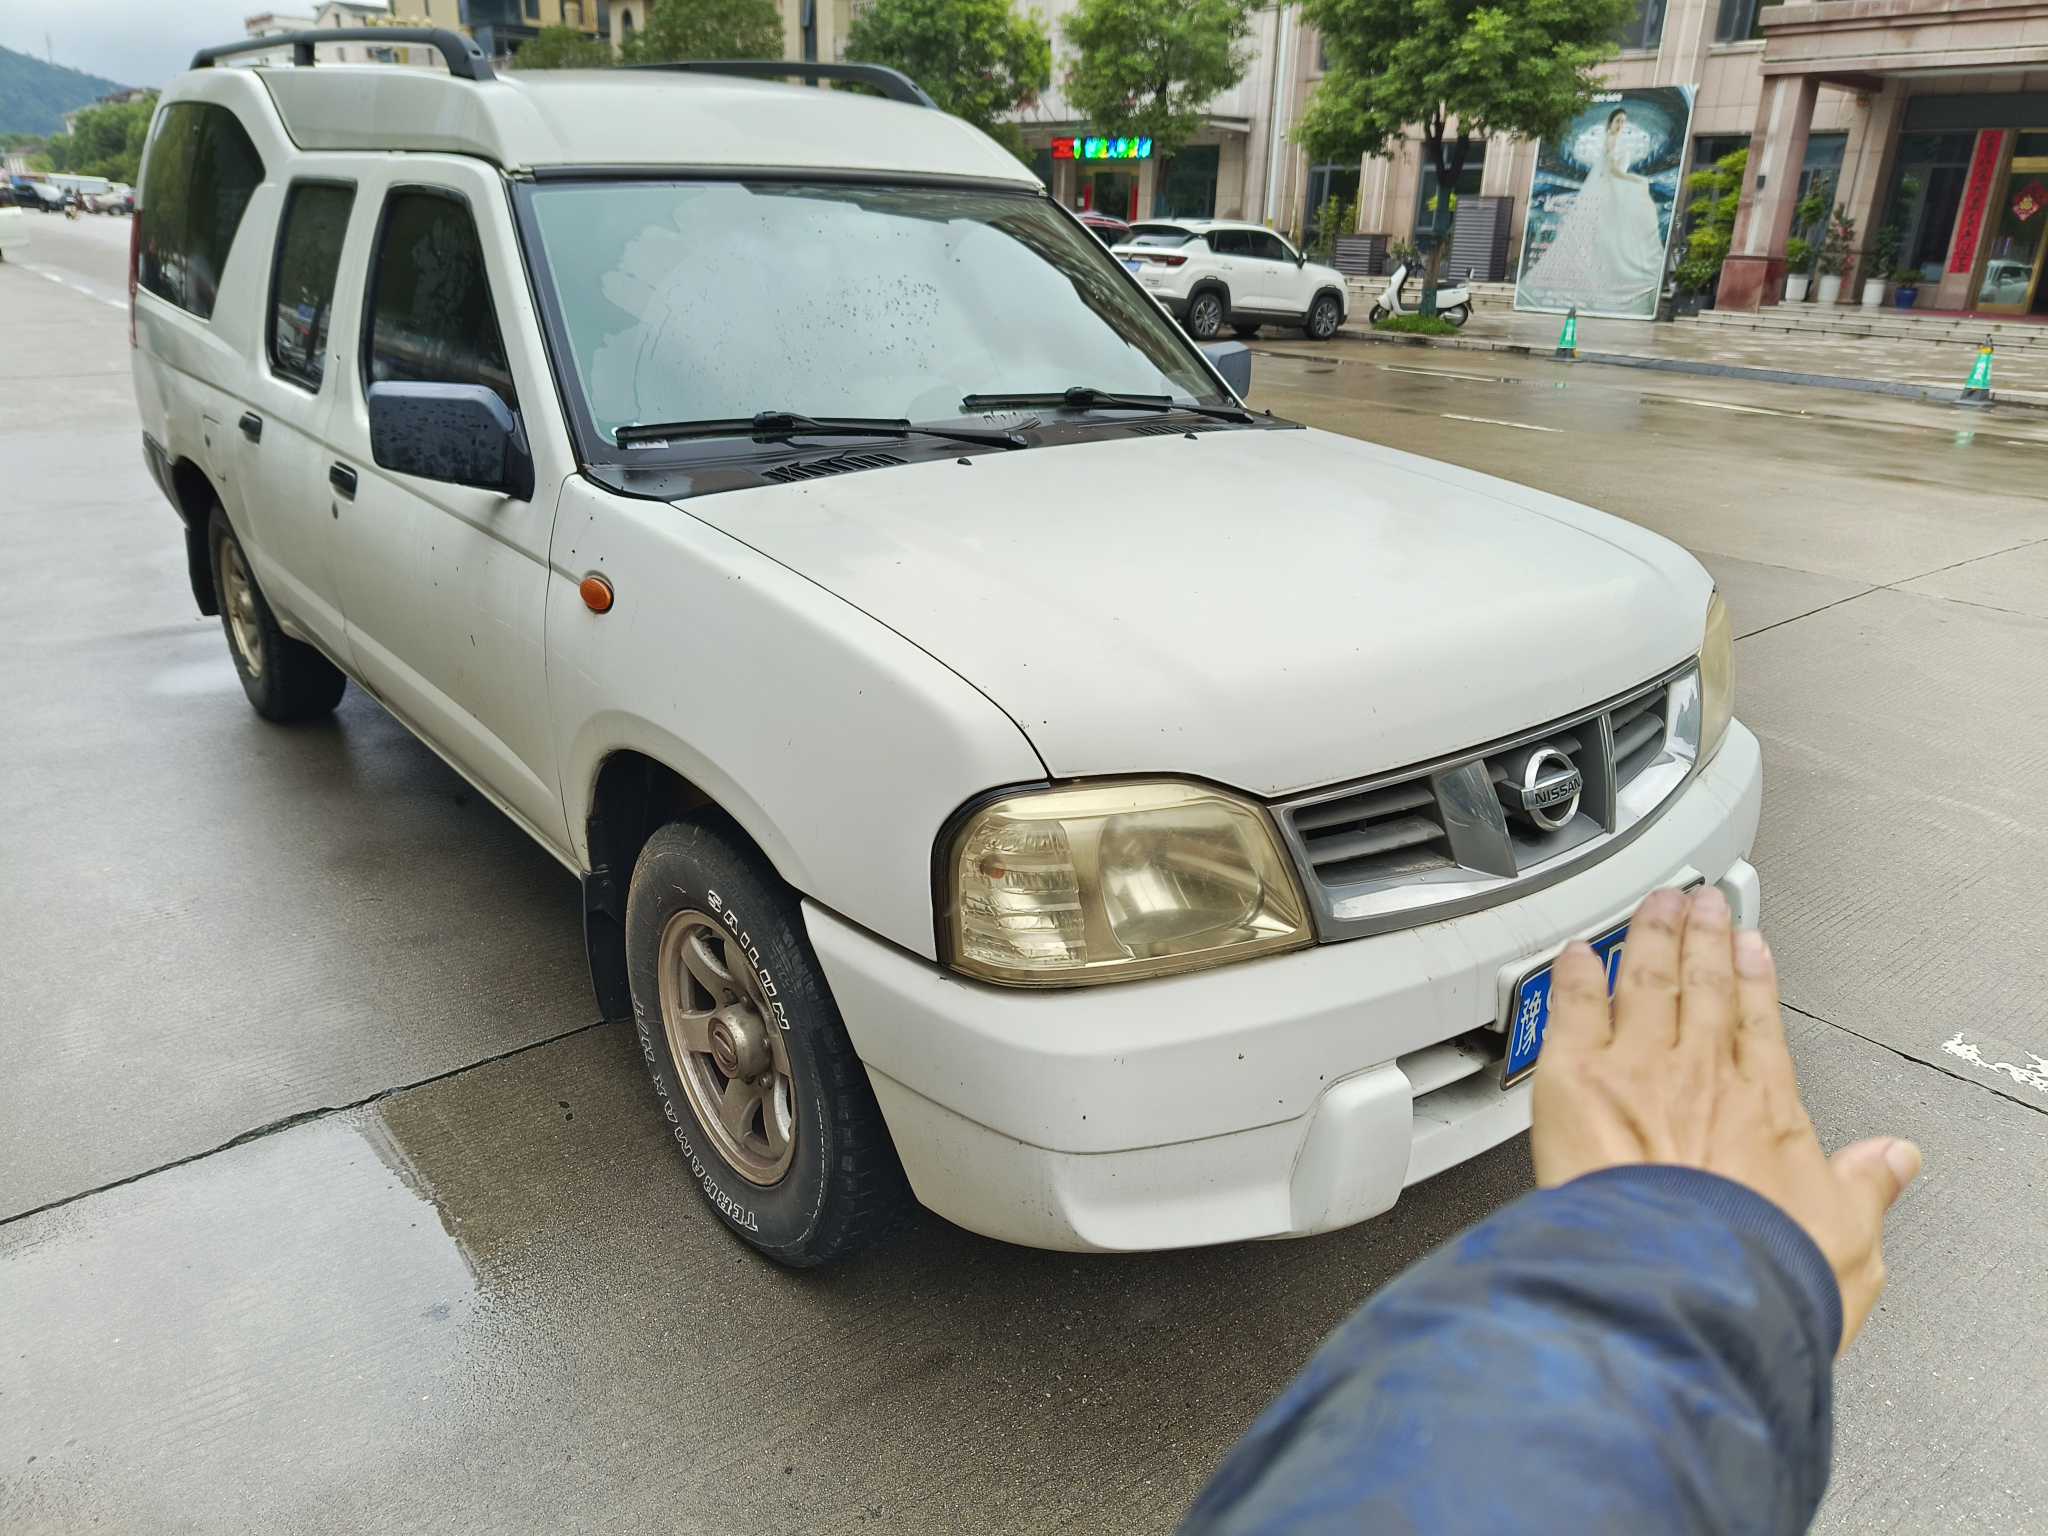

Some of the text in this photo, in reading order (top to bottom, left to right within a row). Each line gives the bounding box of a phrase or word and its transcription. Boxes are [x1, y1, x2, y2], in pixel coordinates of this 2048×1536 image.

[1535, 777, 1581, 804] NISSAN
[707, 889, 791, 1031] SAILUN
[653, 1073, 759, 1233] TERRAMAX
